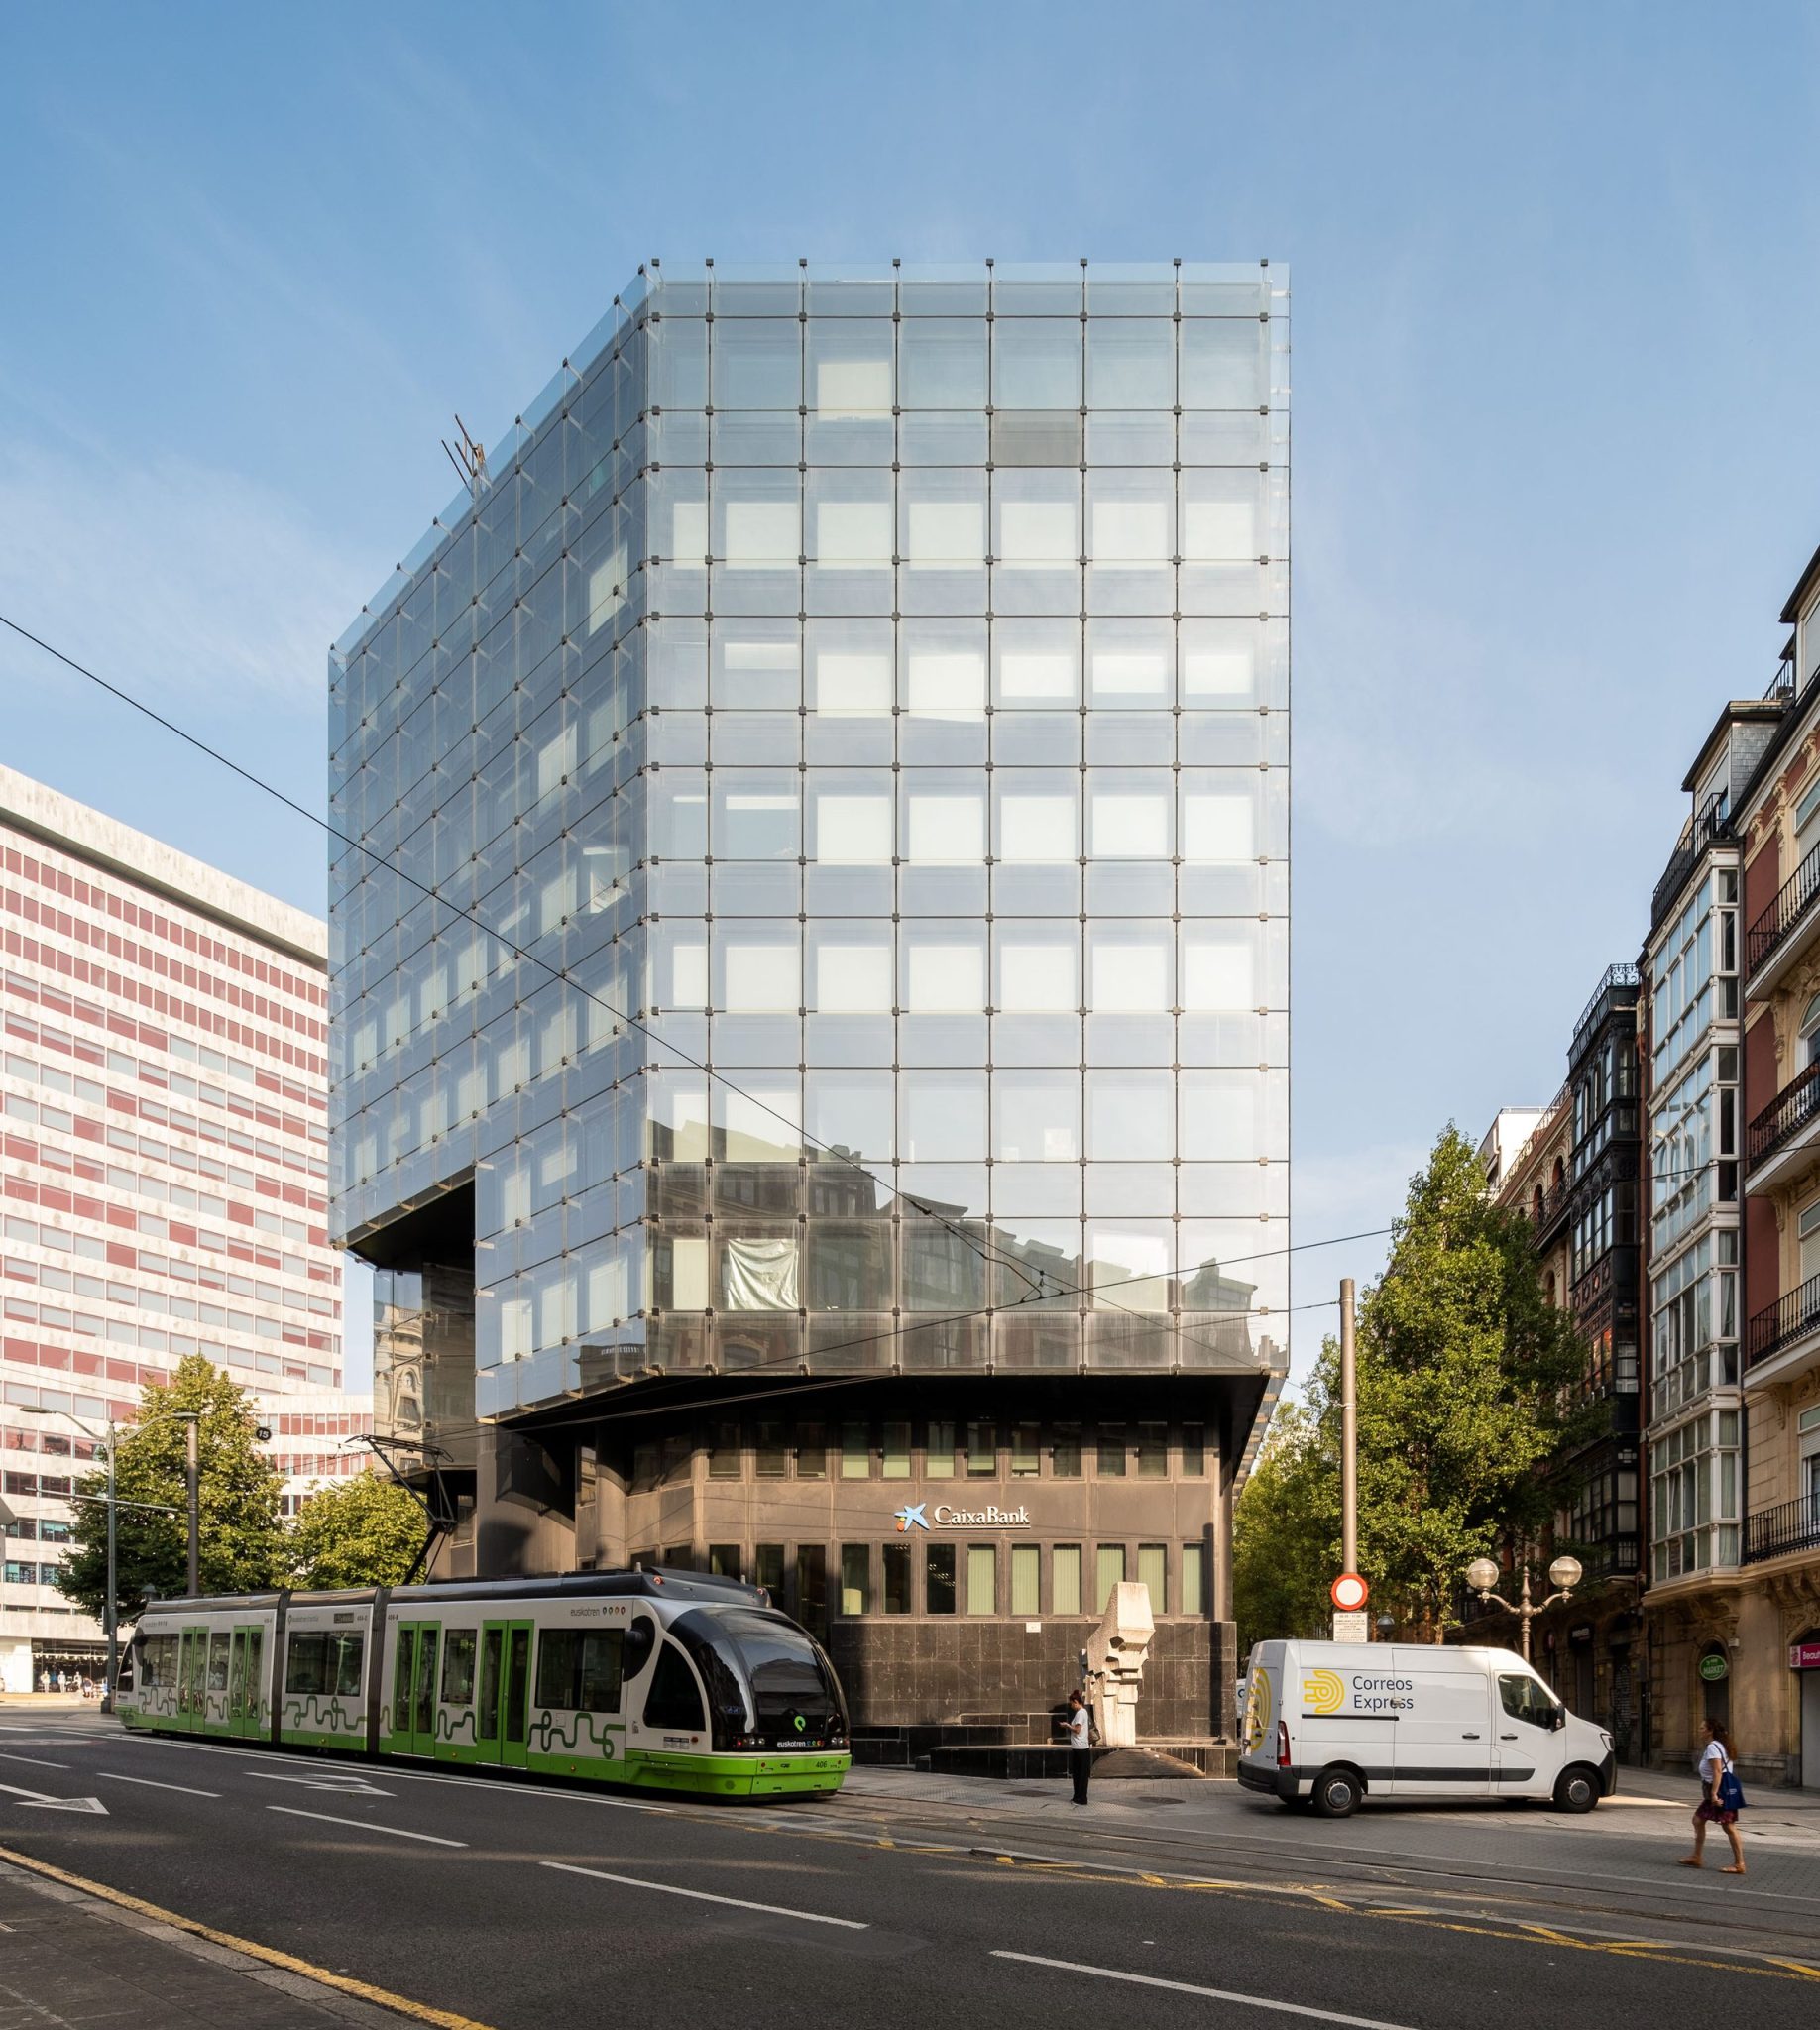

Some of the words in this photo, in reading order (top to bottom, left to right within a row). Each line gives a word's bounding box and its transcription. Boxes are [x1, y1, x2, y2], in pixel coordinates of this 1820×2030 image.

[258, 1429, 270, 1439] 15
[934, 1505, 1031, 1524] CaixaBank
[570, 1607, 601, 1617] euskotren
[1704, 1665, 1723, 1674] MARKET
[1352, 1675, 1413, 1691] Correos
[1353, 1694, 1414, 1713] Express
[815, 1760, 828, 1769] 406
